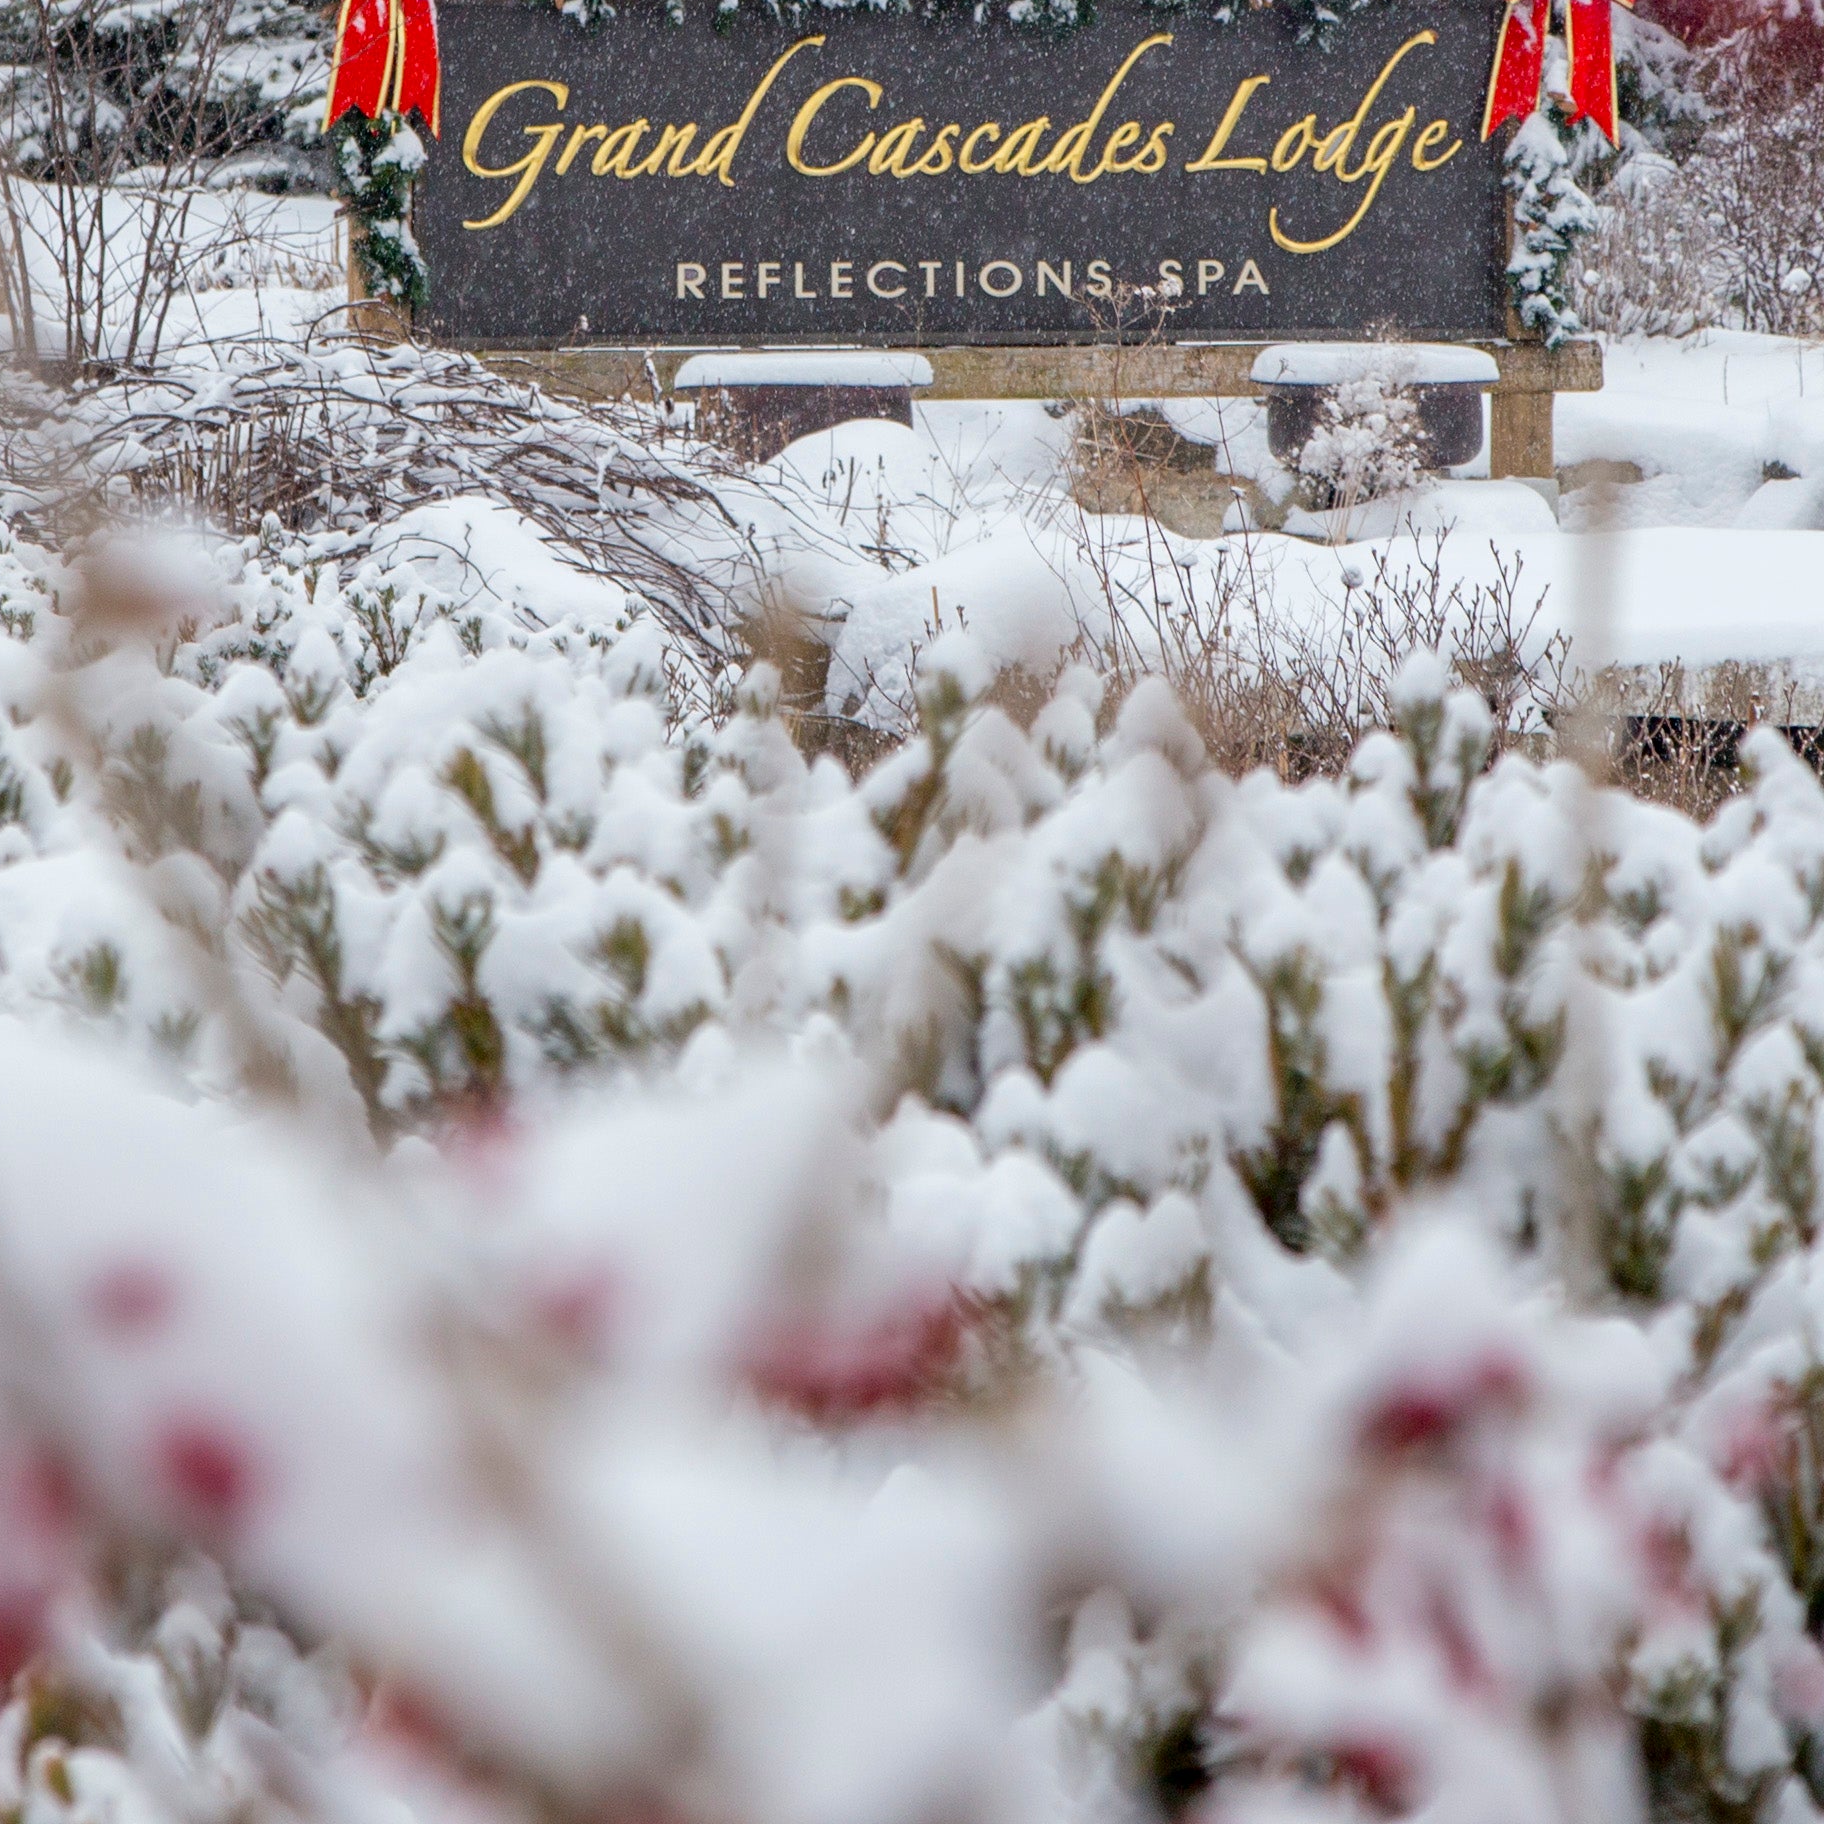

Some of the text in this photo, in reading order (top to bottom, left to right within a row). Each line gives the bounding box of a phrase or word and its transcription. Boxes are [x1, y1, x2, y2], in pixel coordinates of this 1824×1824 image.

[462, 29, 1464, 255] Grand Cascades Lodge
[676, 258, 1271, 299] REFLECTIONS SPA
